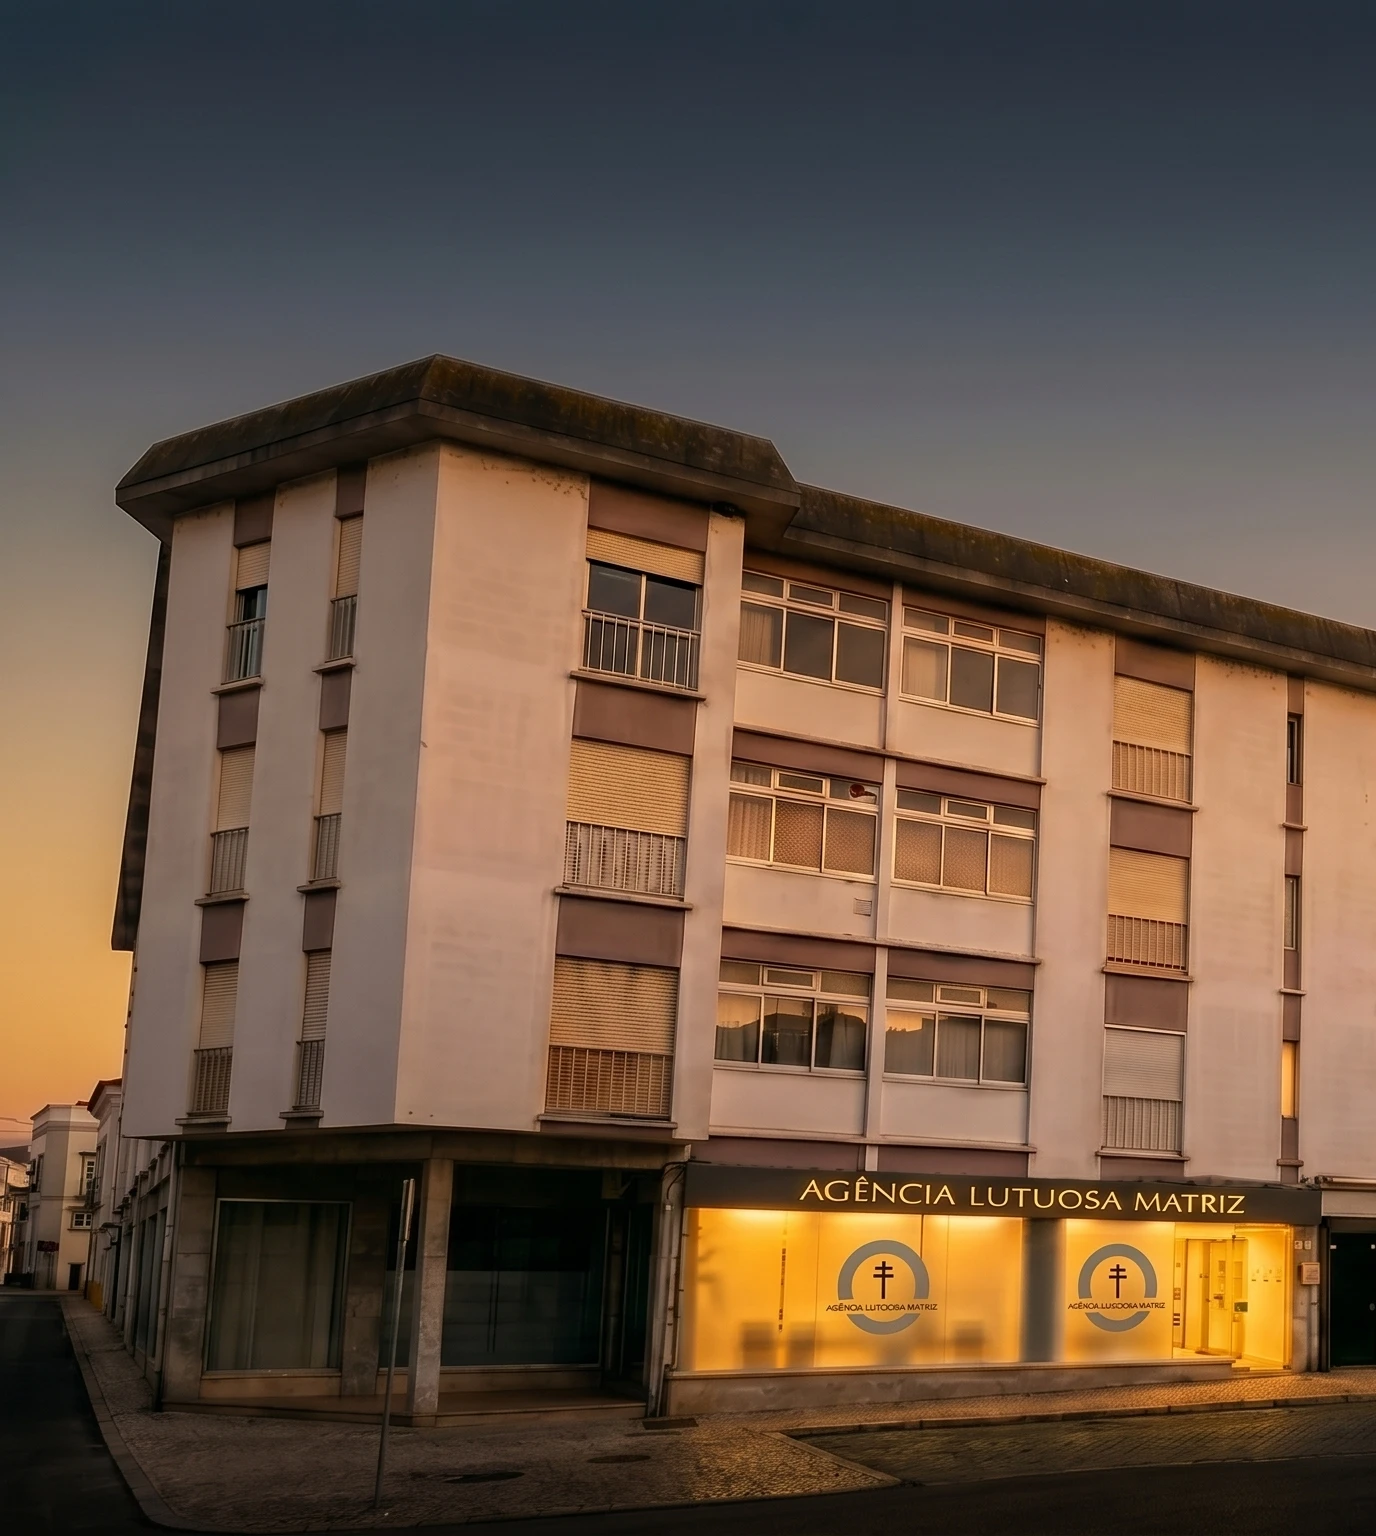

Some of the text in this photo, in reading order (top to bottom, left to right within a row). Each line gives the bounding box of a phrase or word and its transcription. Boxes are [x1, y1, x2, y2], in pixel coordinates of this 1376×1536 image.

[799, 1175, 1246, 1214] AGÊNCIA LUTUOSA MATRIZ
[907, 1303, 938, 1311] MATRIZ
